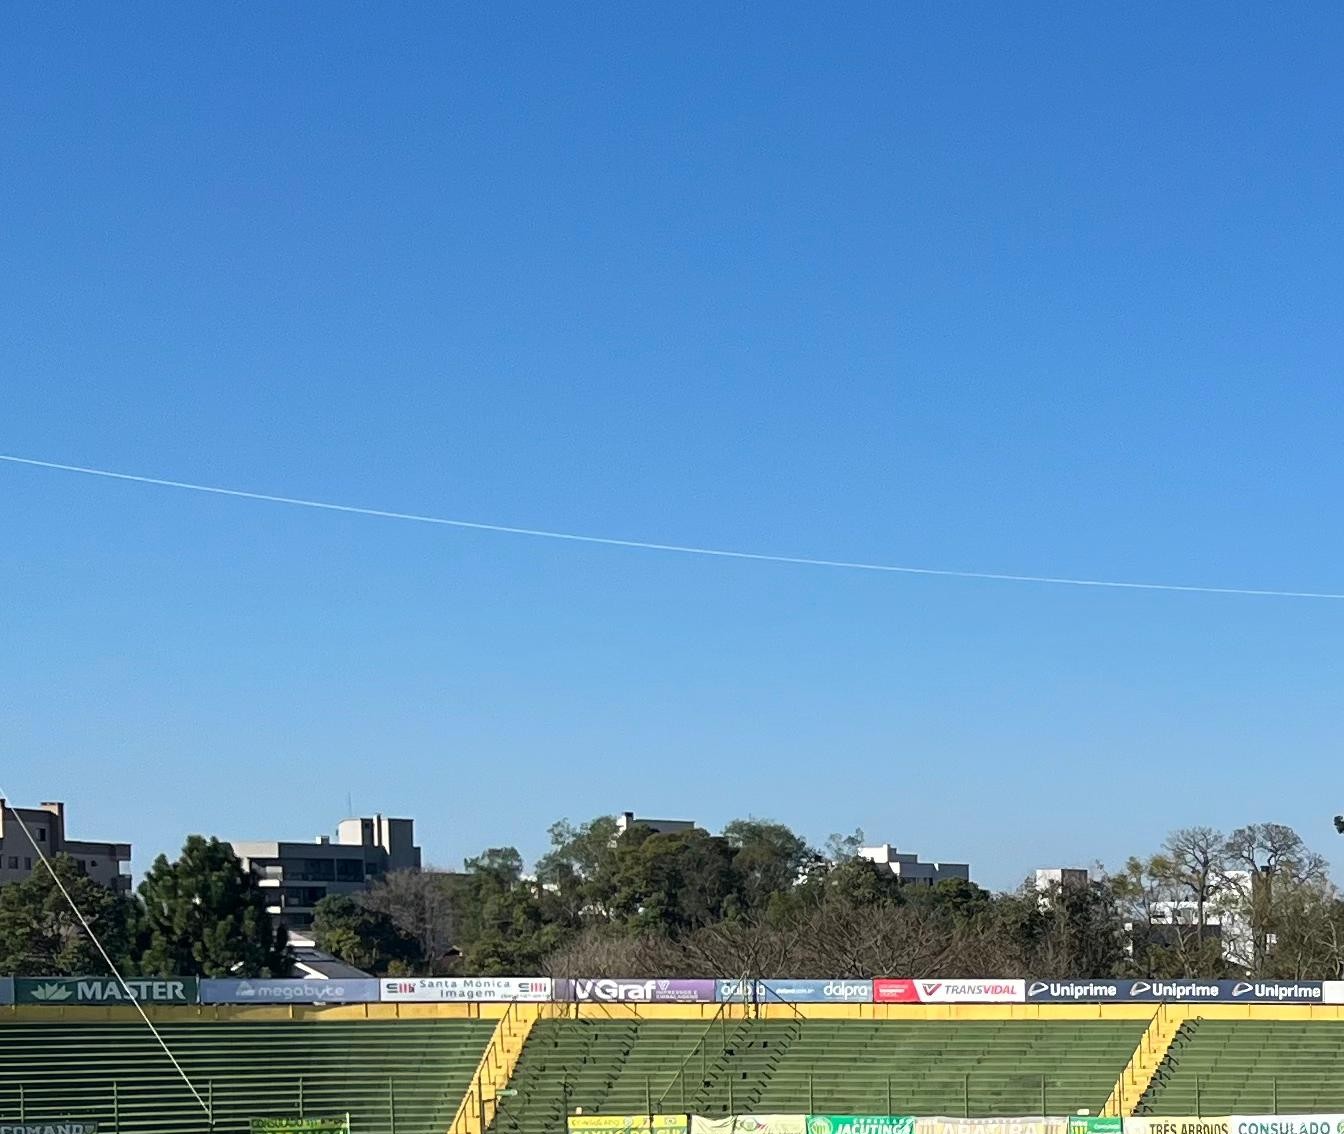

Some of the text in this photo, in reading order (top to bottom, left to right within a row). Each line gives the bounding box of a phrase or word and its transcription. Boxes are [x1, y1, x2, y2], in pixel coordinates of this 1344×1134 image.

[77, 981, 187, 1001] MASTER
[419, 979, 458, 988] Santa
[823, 981, 868, 1000] dalpra
[944, 985, 1017, 995] TRANSVIDAL
[1050, 983, 1117, 999] Uniprime
[1152, 983, 1219, 999] Uniprime
[1254, 983, 1321, 999] Uniprime
[258, 985, 345, 999] megabyte
[440, 989, 496, 999] Imagem
